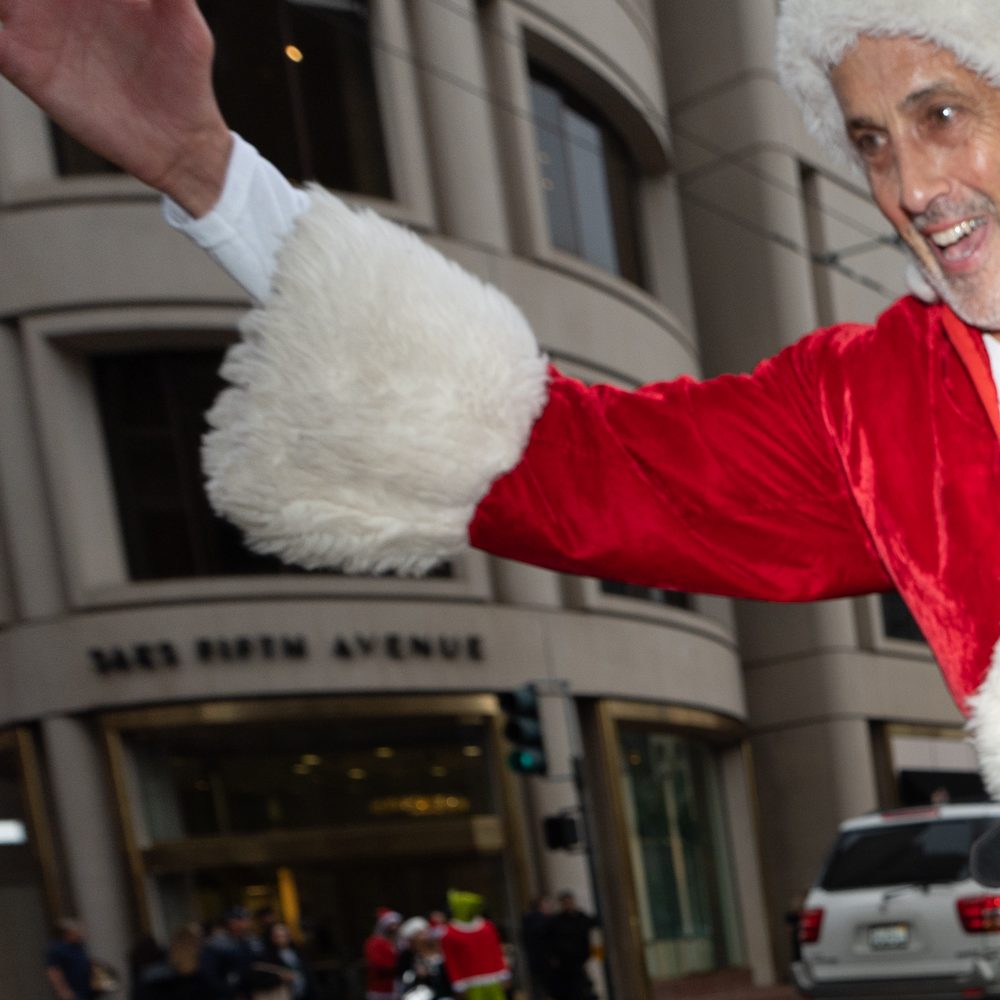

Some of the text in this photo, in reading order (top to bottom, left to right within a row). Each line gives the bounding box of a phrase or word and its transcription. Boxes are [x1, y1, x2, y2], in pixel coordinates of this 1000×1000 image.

[89, 633, 483, 674] SAKS FIFTH AVENUE
